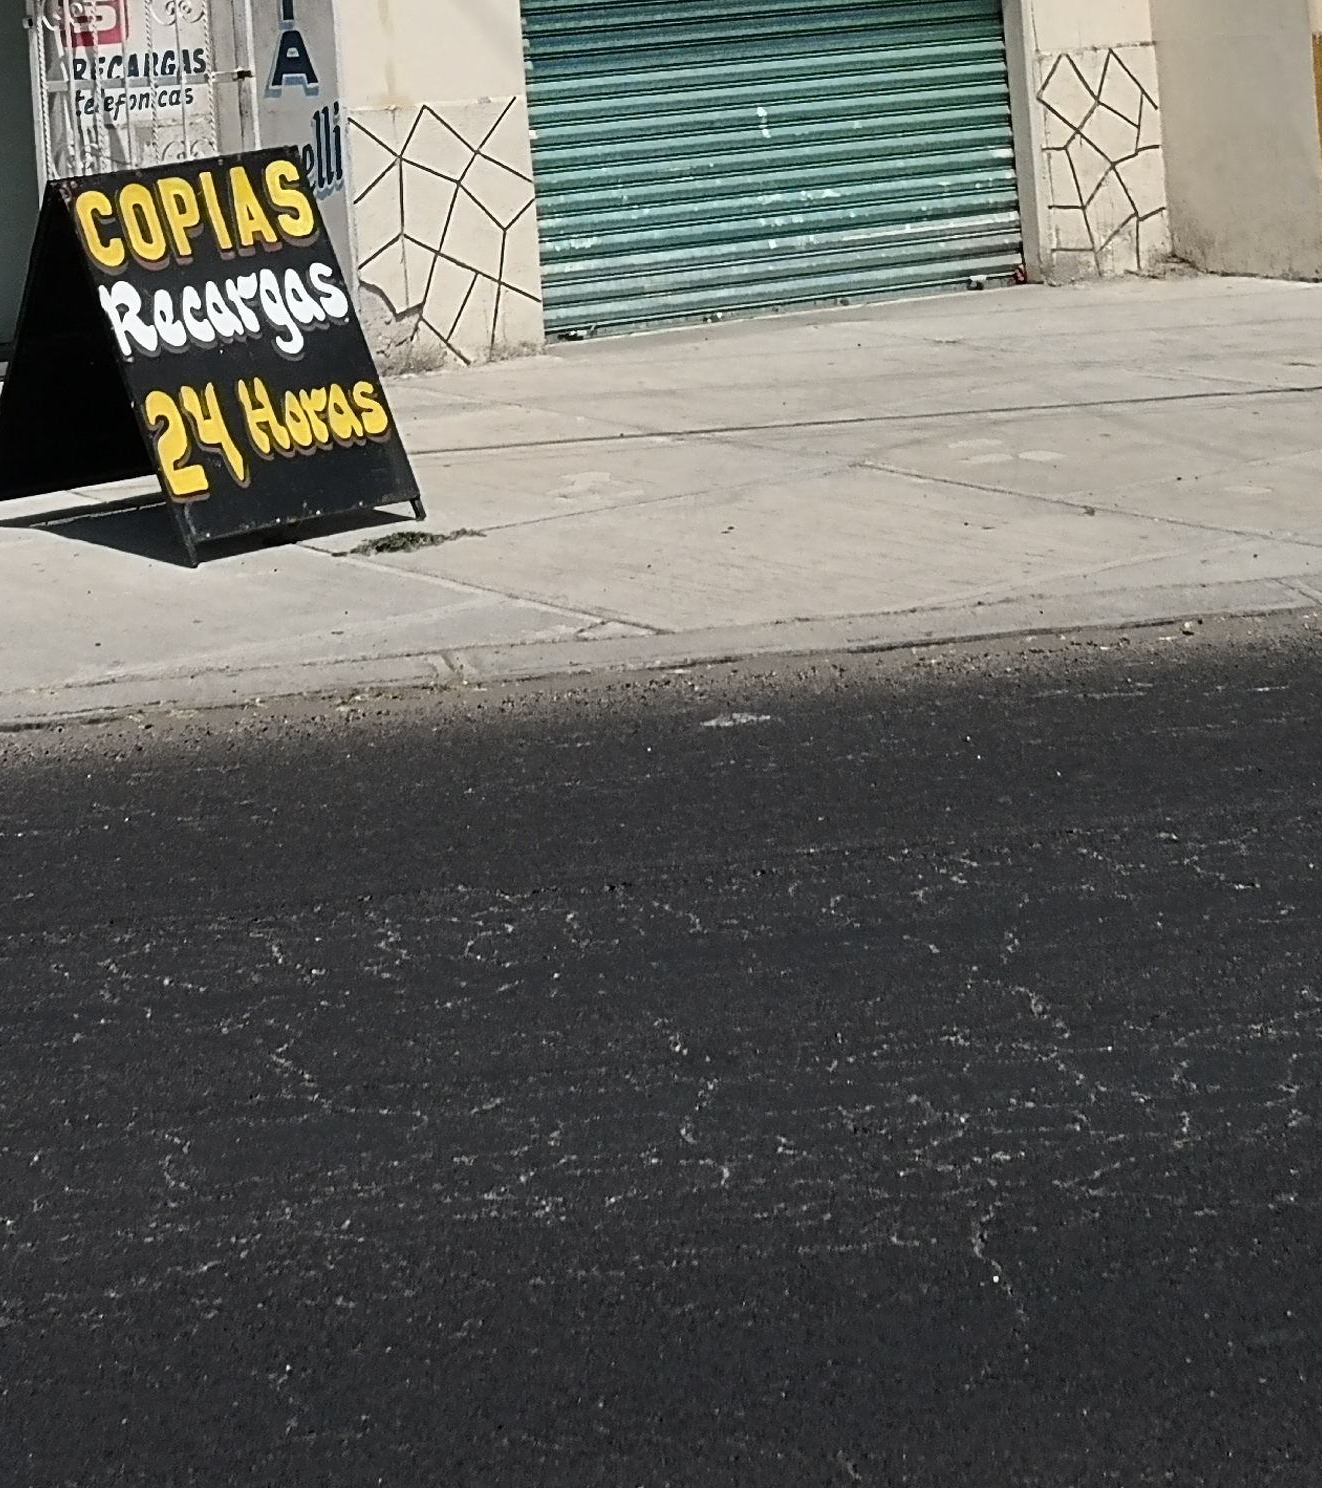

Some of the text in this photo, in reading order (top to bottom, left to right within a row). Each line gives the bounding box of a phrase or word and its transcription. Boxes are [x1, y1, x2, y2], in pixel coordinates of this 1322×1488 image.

[74, 159, 316, 271] COPIAS
[98, 262, 350, 359] Recargas
[143, 377, 390, 500] 24 Horas
